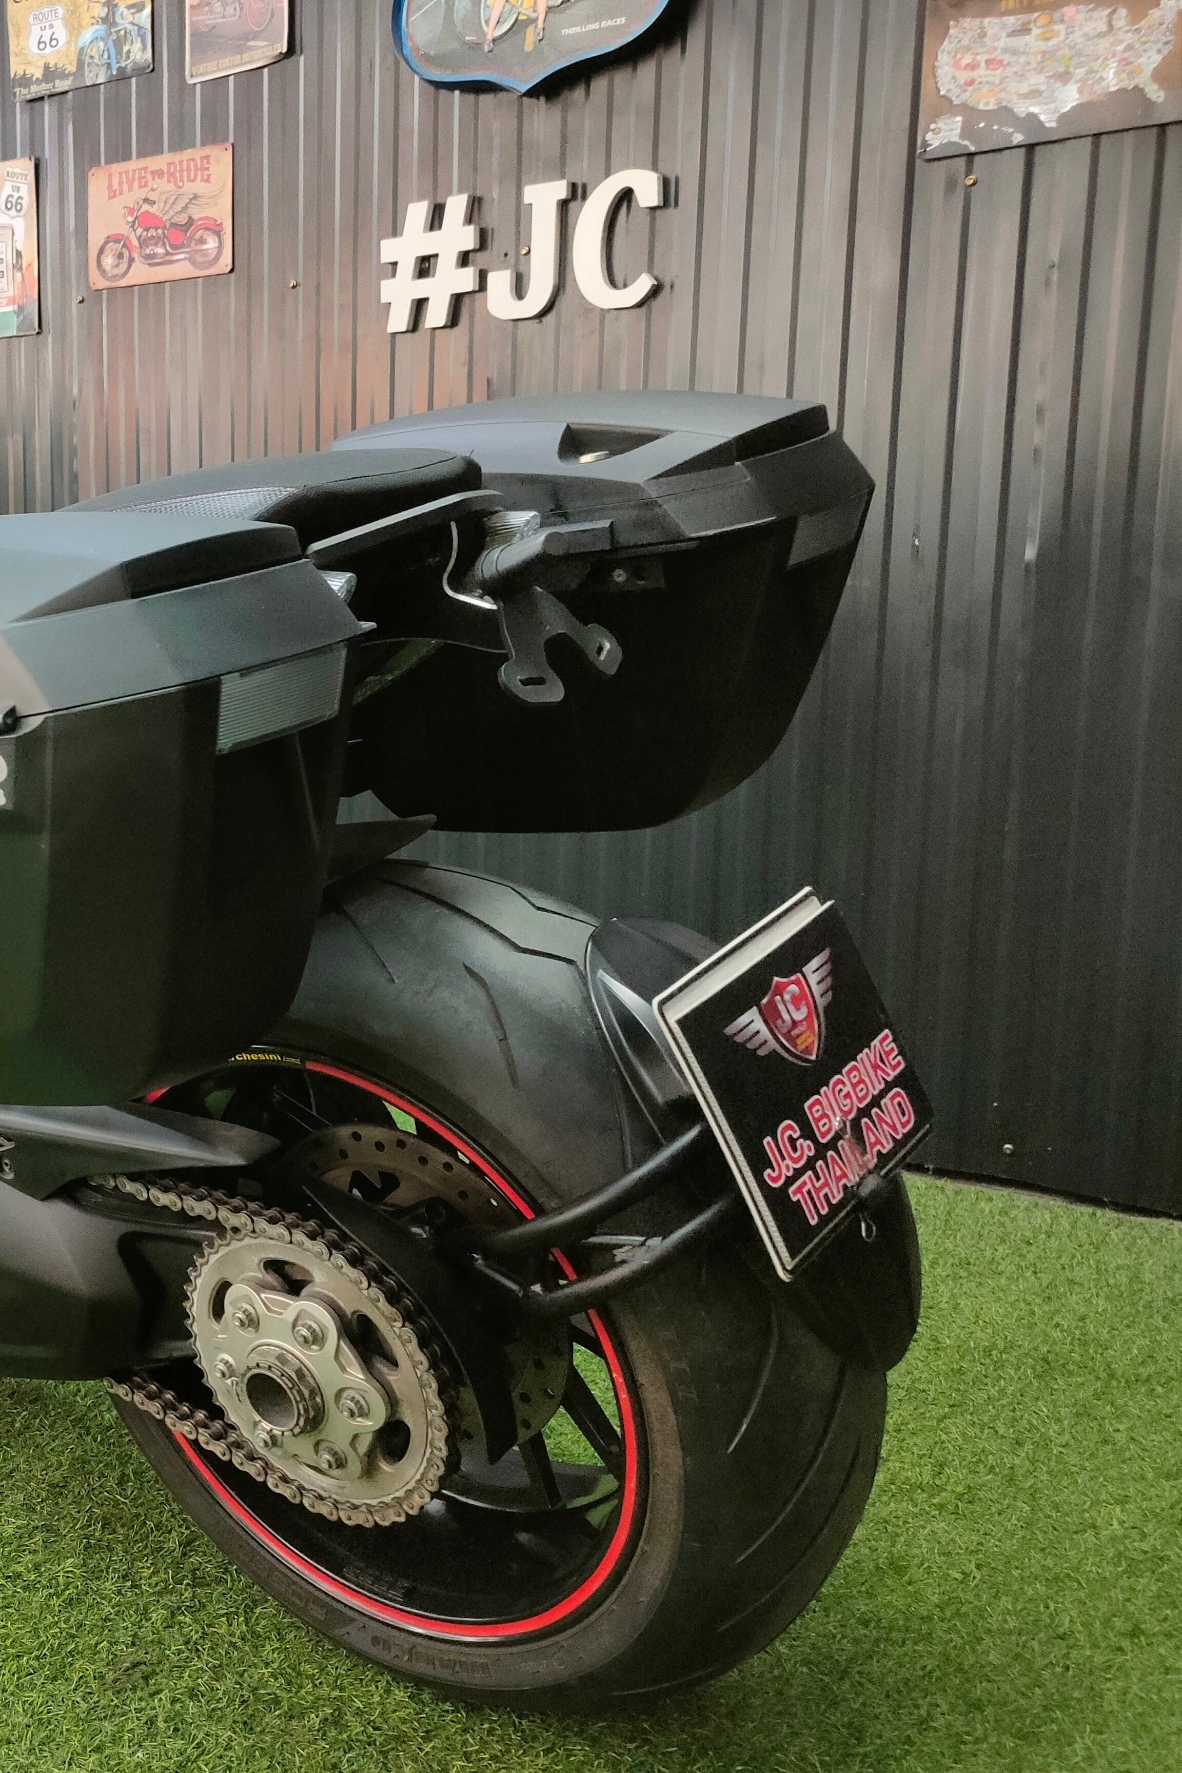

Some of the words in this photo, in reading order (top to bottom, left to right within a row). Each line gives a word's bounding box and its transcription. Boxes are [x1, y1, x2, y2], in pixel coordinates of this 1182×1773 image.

[32, 8, 60, 23] ROUTE
[40, 23, 54, 31] US
[561, 21, 600, 36] THRILLING
[601, 16, 626, 28] RACES
[37, 31, 59, 51] 66
[6, 170, 28, 181] ROUTE
[107, 166, 148, 201] LIVE
[149, 168, 165, 181] TO
[165, 155, 211, 189] RIDE
[11, 185, 20, 193] US
[5, 194, 23, 213] 66
[380, 169, 664, 334] #JC
[774, 984, 808, 1033] JC
[763, 1119, 815, 1188] J.C.
[803, 1028, 905, 1145] BIGBIKE
